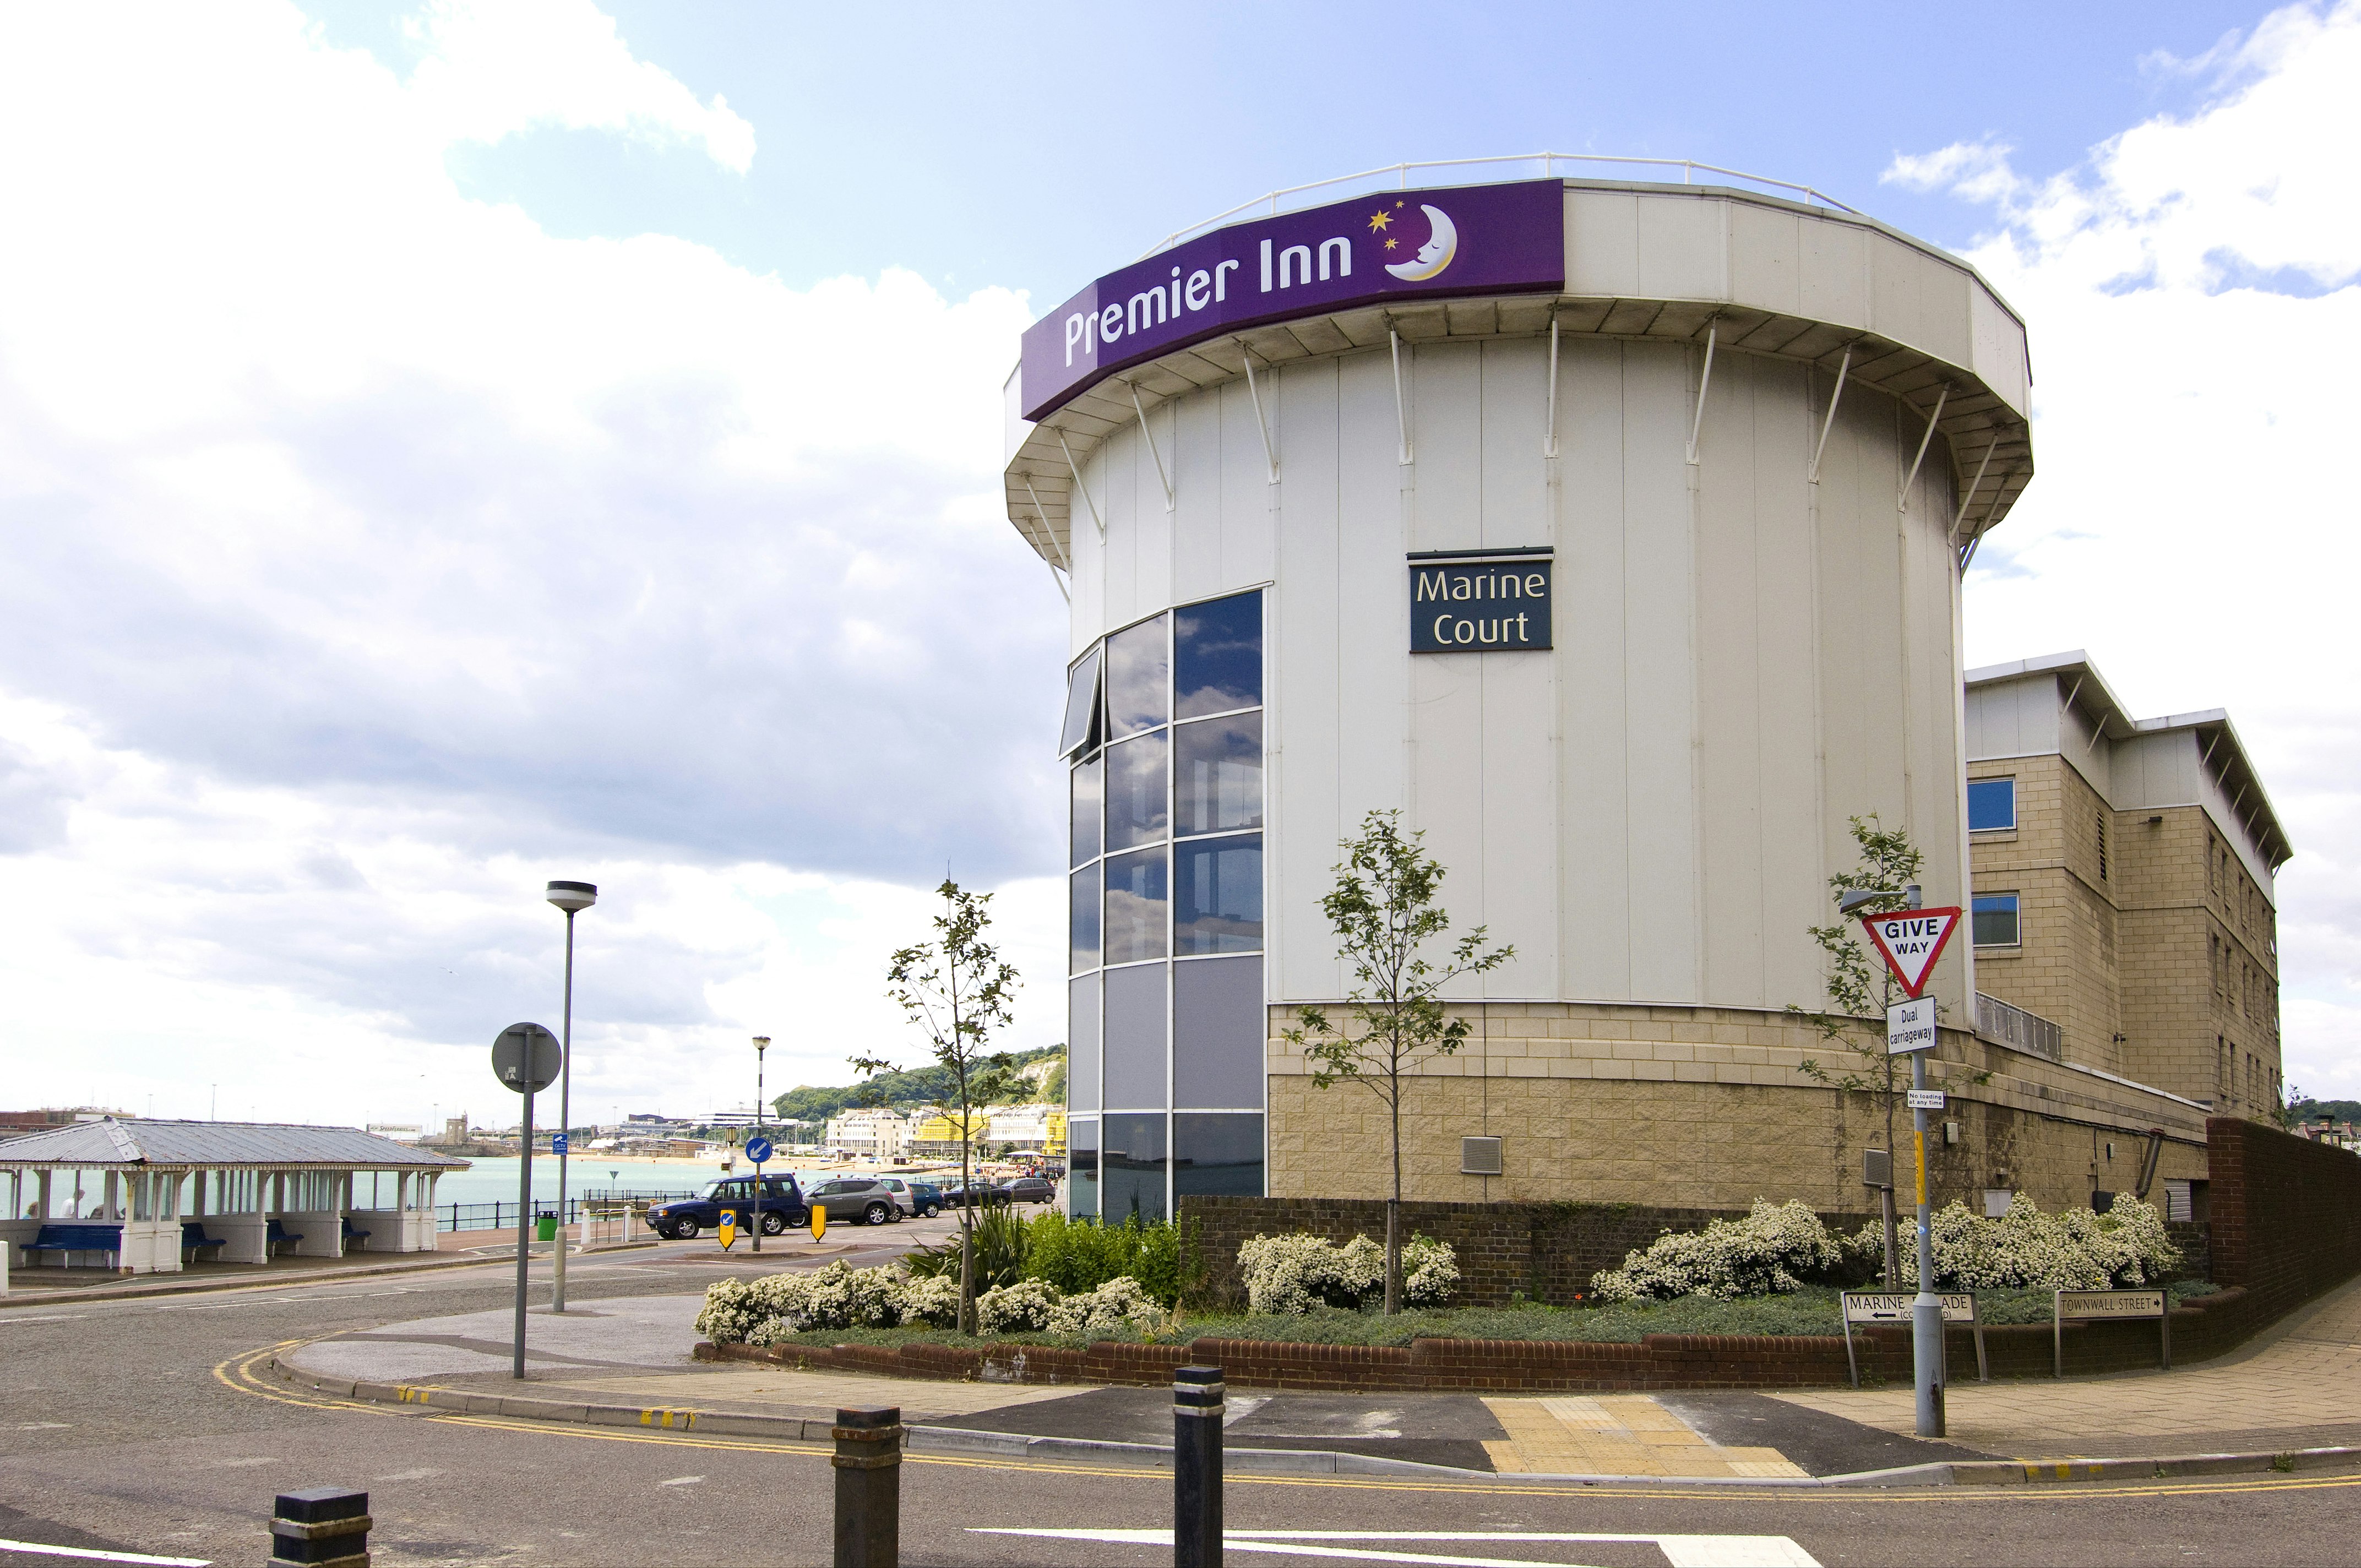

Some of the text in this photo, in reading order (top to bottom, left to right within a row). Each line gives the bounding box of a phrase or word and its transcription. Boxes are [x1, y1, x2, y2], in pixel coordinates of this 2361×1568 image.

[1065, 236, 1352, 368] Premier Inn
[1417, 568, 1546, 602] Marine
[1434, 612, 1529, 645] Court
[1885, 918, 1939, 939] GIVE
[1895, 941, 1929, 955] WAY
[1901, 1006, 1918, 1023] Dual
[1890, 1027, 1932, 1045] carriageway
[1849, 1296, 1905, 1310] MARINE
[2061, 1298, 2151, 1311] TOWNWALL STREET
